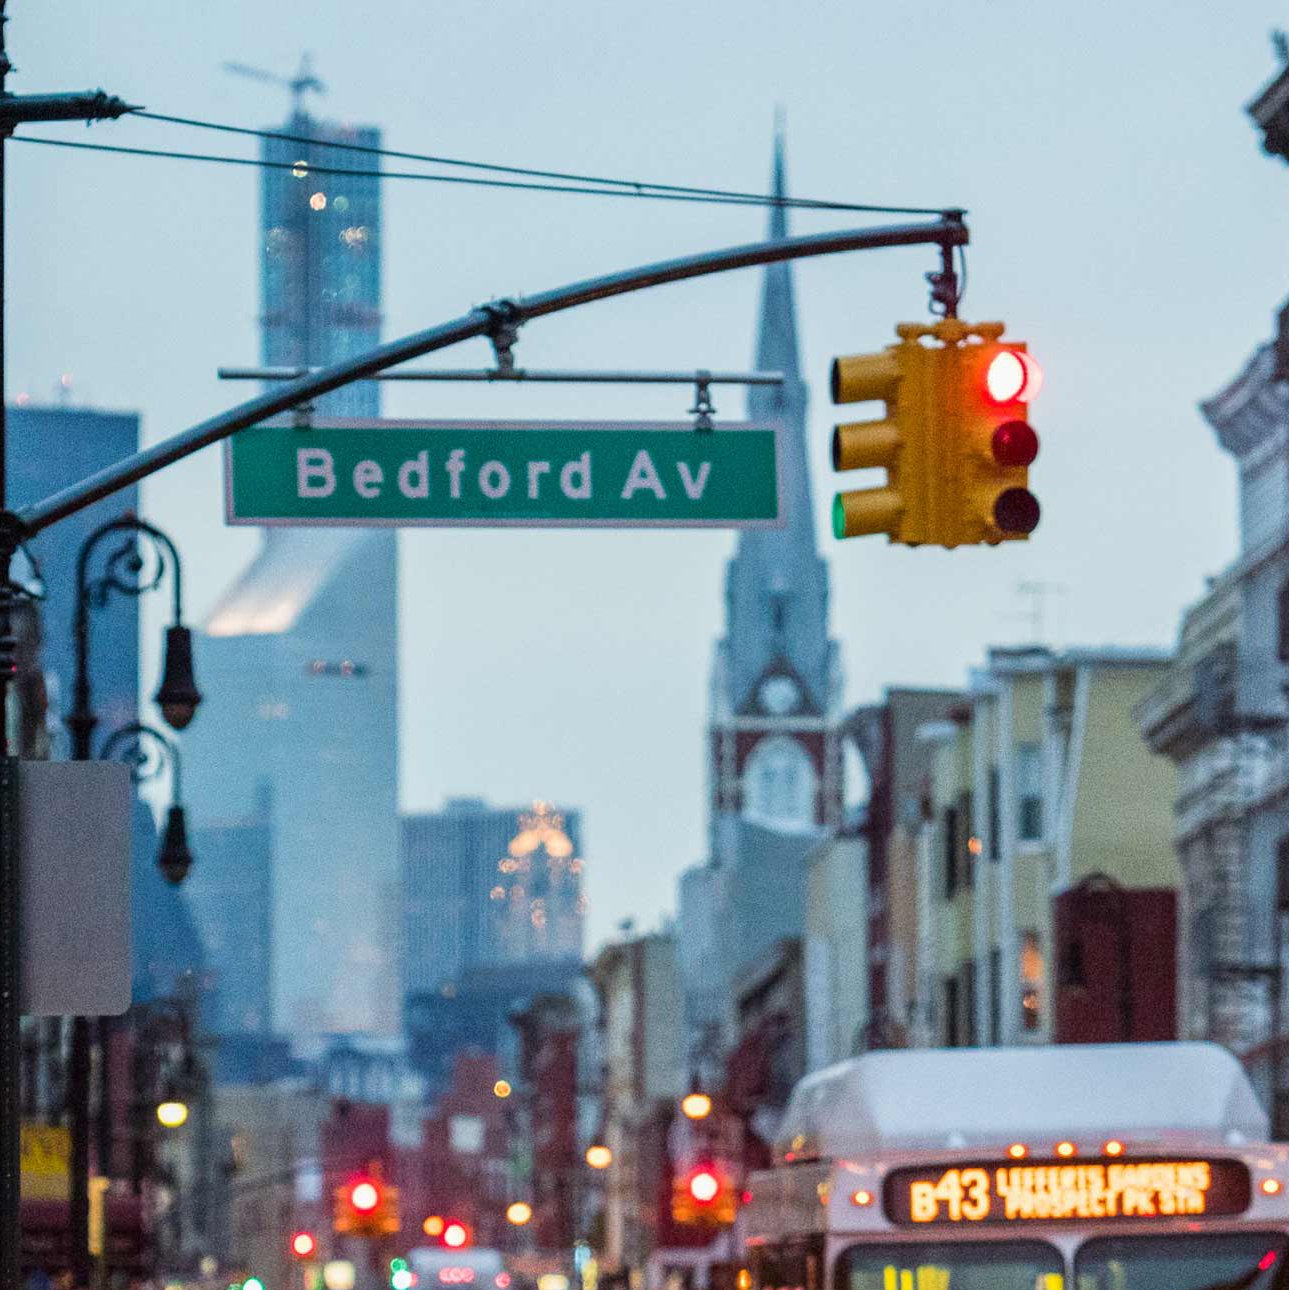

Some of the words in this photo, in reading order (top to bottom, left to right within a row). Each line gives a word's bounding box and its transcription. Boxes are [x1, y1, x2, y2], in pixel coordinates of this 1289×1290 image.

[296, 447, 592, 500] Bedford
[619, 449, 712, 500] Av
[910, 1168, 990, 1222] B43
